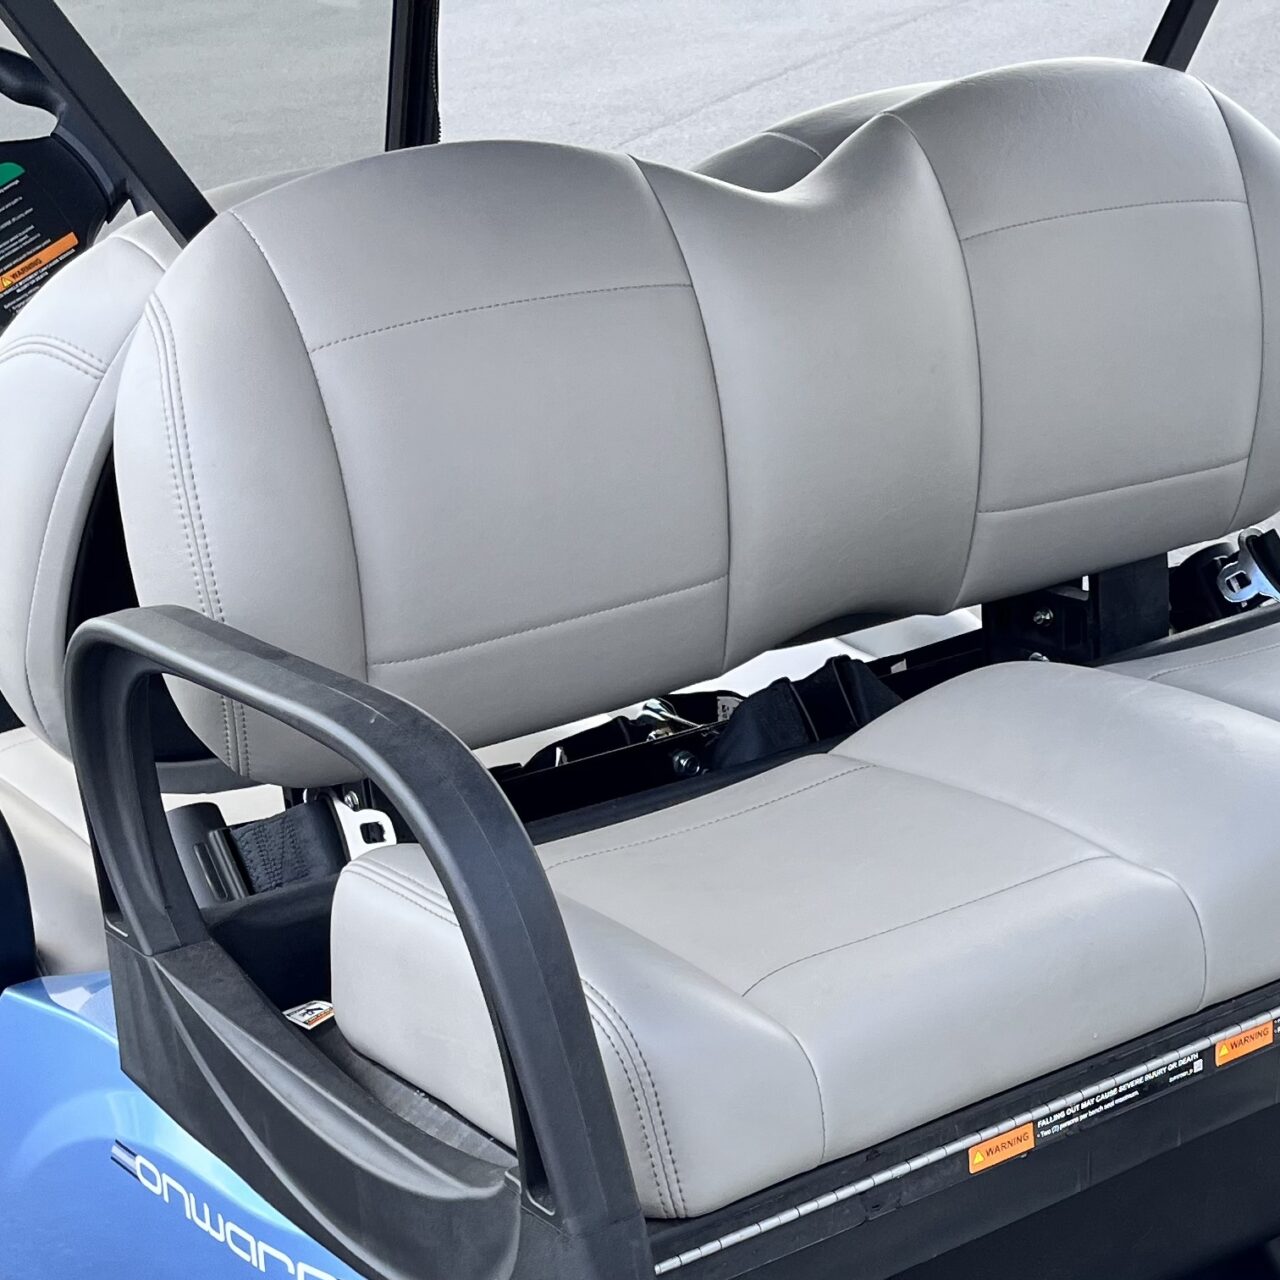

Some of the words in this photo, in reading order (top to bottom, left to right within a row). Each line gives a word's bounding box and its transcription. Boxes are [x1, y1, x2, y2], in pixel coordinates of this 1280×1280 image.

[10, 258, 42, 280] WARNING
[1230, 1027, 1269, 1050] WARNING
[1037, 1110, 1065, 1128] FALLING
[1066, 1103, 1080, 1116] OUT
[1080, 1097, 1095, 1110] MAY
[1095, 1087, 1118, 1103] CAUSE
[1118, 1075, 1145, 1093] SEVERE
[1144, 1066, 1167, 1082] INJURY
[1167, 1061, 1178, 1072] OR
[1178, 1052, 1199, 1067] DEATH
[985, 1131, 1030, 1157] WARNING
